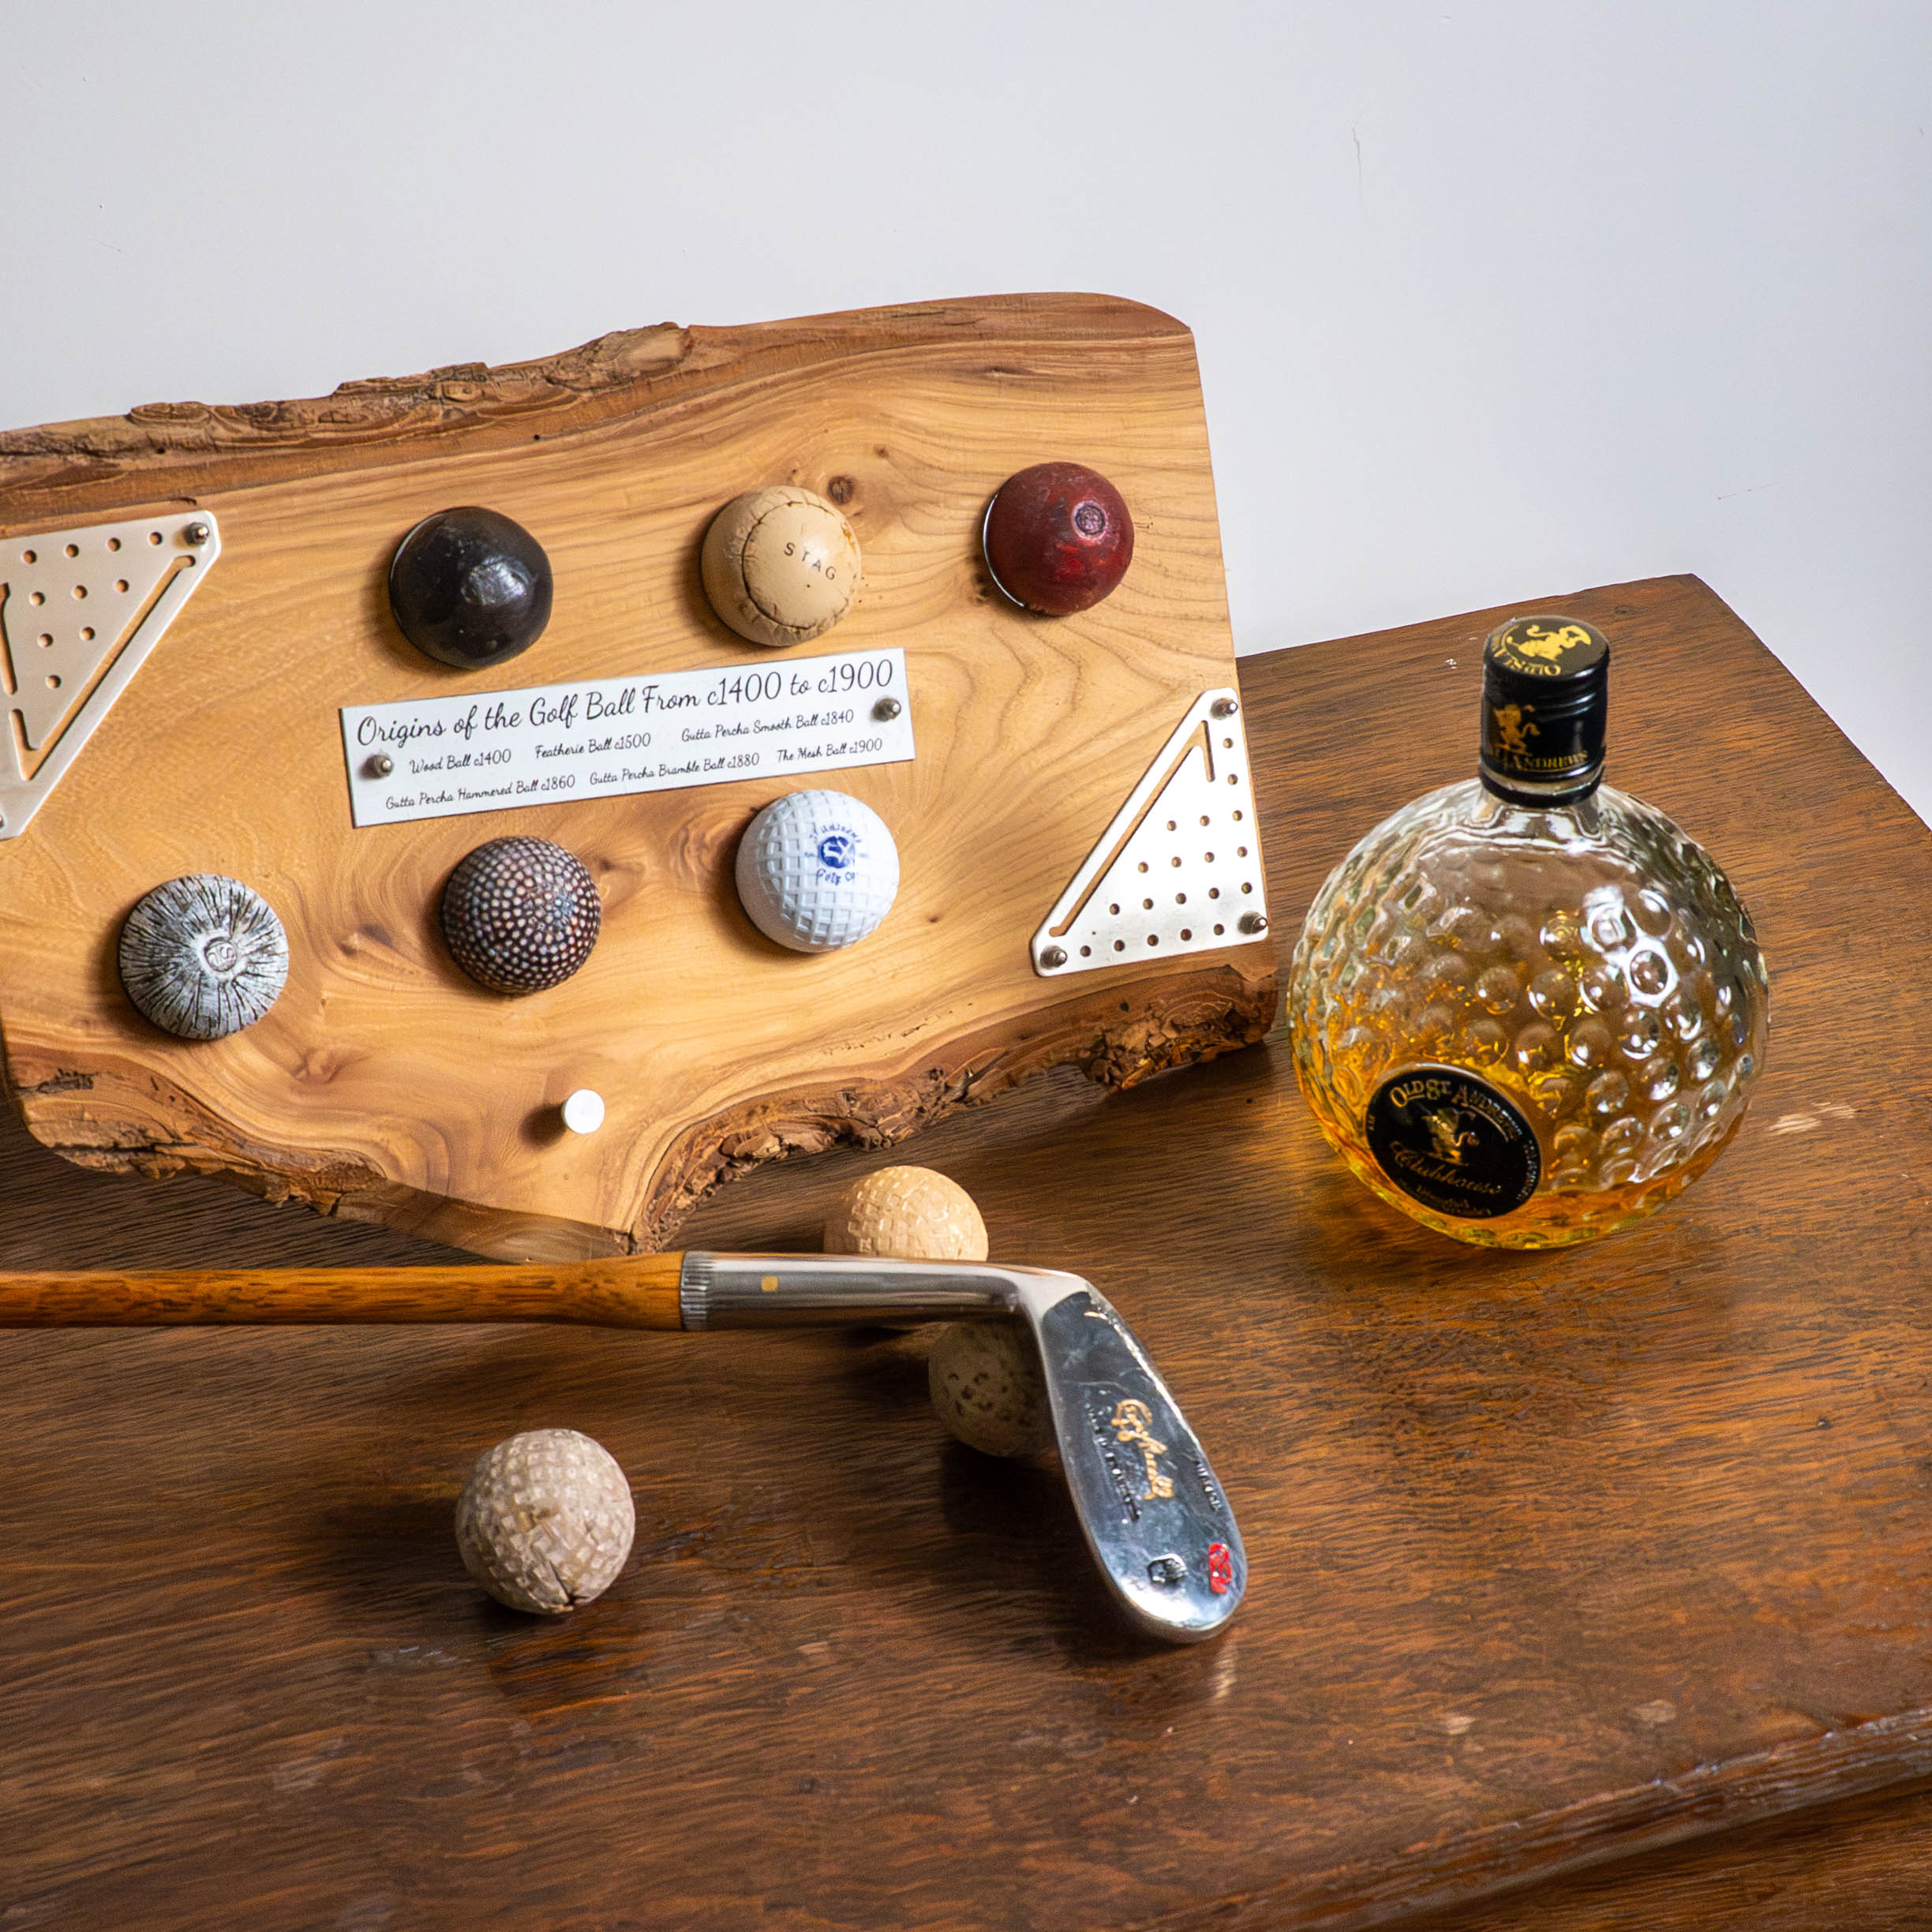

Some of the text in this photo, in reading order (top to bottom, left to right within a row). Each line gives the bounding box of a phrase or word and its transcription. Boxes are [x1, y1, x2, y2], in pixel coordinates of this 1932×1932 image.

[784, 542, 836, 580] STAG
[358, 659, 893, 748] Origins of the Golf Ball From c1400 to c1900
[681, 709, 855, 743] Gutta Percha Smooth Ball c1840
[409, 748, 512, 775] Wood Ball c1400
[534, 732, 652, 760] Featherie Ball c1500
[777, 738, 883, 764] The Mesh Ball c1900
[590, 752, 760, 786] Gutta Percha Bramble Ball c1880
[386, 773, 576, 811] Gutta Percha Hammered Ball c1860
